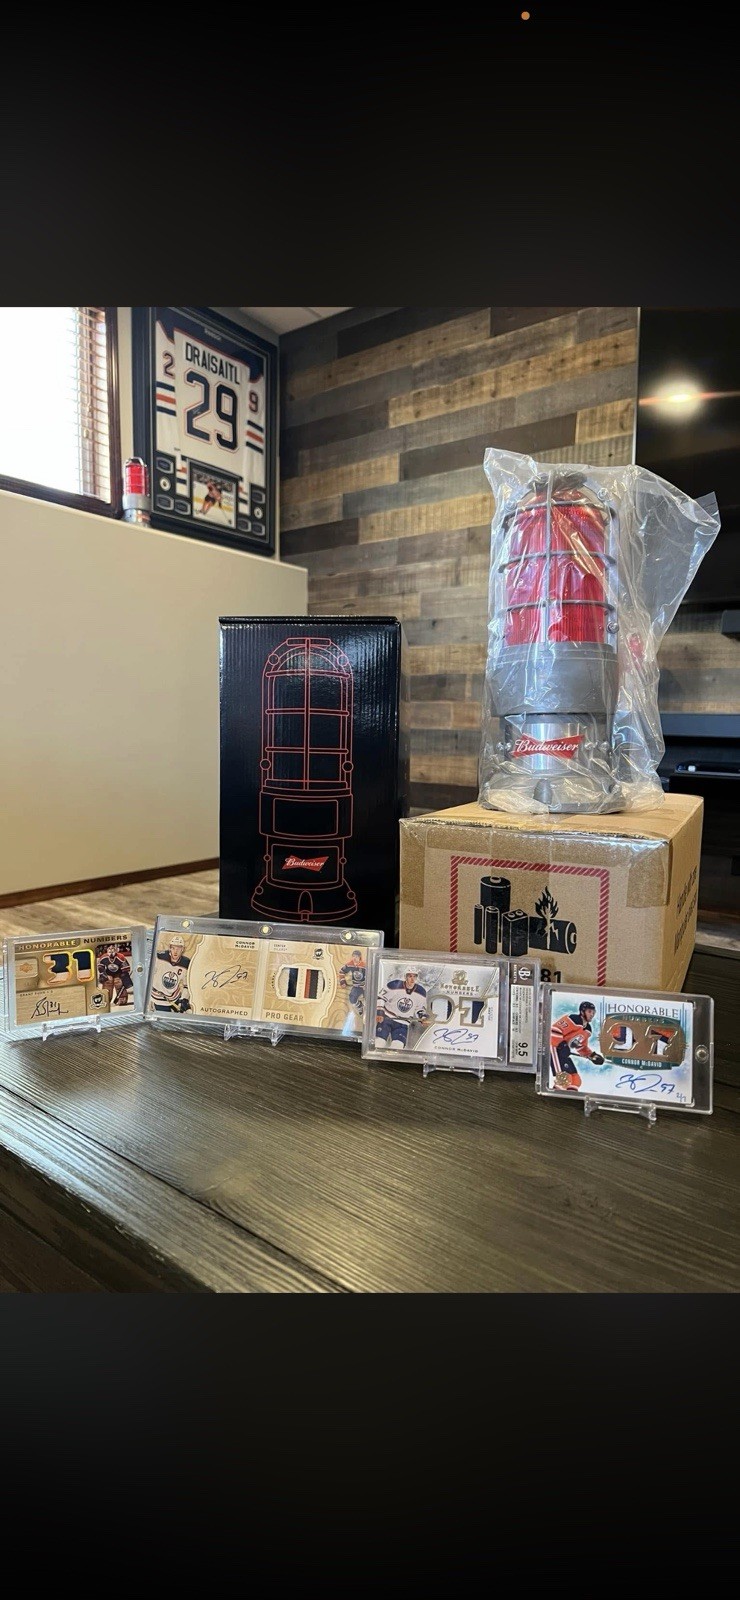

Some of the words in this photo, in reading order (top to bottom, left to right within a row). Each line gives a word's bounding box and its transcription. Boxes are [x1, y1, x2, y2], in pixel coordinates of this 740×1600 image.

[163, 350, 175, 379] 2
[185, 341, 240, 385] DRAISAITL
[184, 367, 239, 454] 29
[514, 739, 579, 752] Budweiser
[284, 856, 325, 868] Budweiser
[18, 939, 77, 951] HONORABLE
[83, 934, 129, 944] NUMBERS
[43, 949, 95, 985] 31
[440, 983, 480, 993] HONORABLE
[200, 1006, 248, 1016] AUTOGRAPHED
[265, 1011, 281, 1020] PRO
[283, 1013, 304, 1022] GEAR
[607, 1003, 680, 1018] HONORABLE
[607, 1023, 678, 1058] 97
[518, 1042, 528, 1057] 9.5
[621, 1058, 640, 1066] CONNOR
